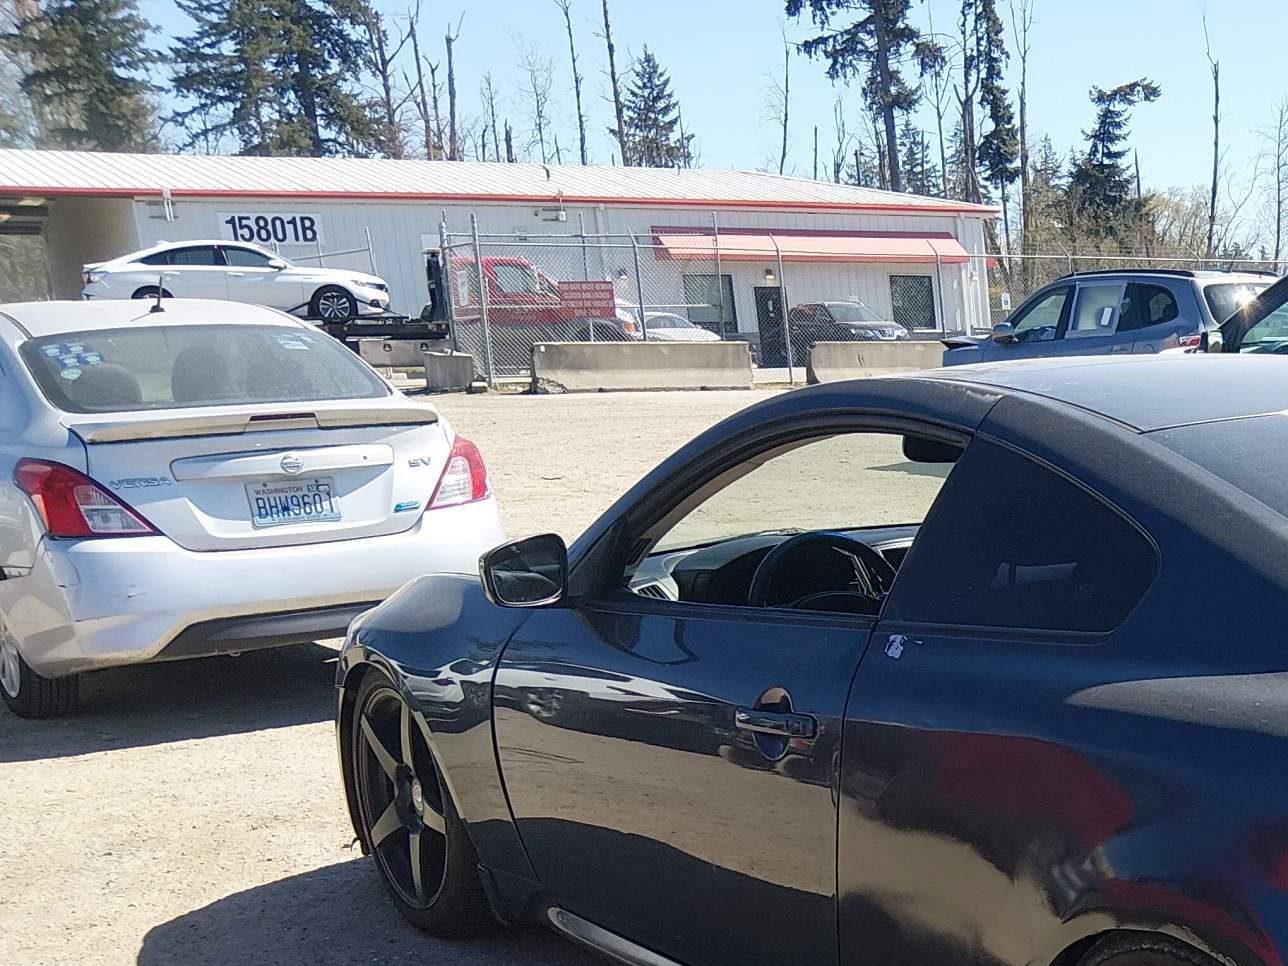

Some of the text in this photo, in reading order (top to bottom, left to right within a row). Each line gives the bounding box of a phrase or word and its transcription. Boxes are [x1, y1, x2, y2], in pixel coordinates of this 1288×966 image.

[225, 215, 317, 242] 15801B
[110, 477, 171, 490] VERSA
[254, 486, 303, 496] WASHINGTON
[255, 493, 334, 519] BHW9601
